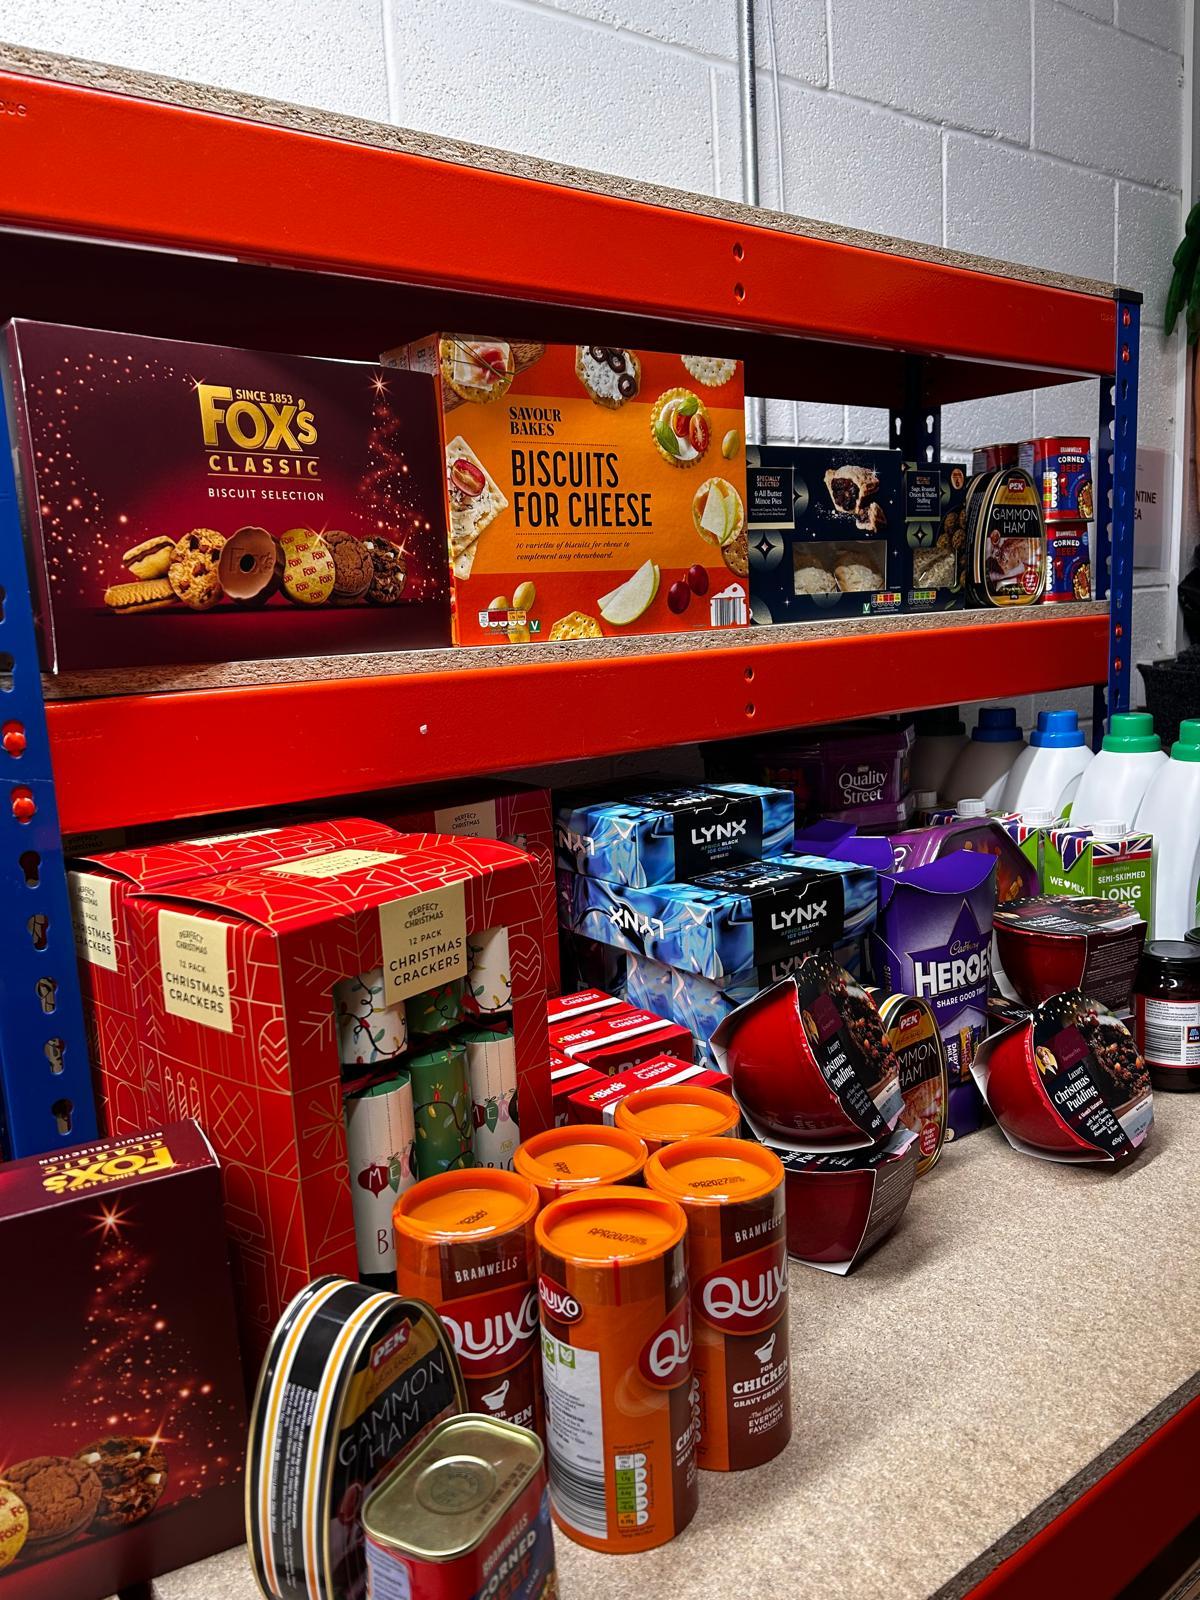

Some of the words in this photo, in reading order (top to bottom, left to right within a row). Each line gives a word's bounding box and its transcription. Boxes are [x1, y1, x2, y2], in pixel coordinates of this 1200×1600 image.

[235, 388, 267, 402] SINCE
[269, 393, 294, 404] 1853
[509, 406, 561, 422] SAVOUR
[510, 421, 555, 436] BAKES
[208, 455, 319, 476] CLASSIC
[1058, 455, 1085, 464] CORNED
[1060, 464, 1082, 472] BEEF
[511, 449, 619, 488] BISCUITS
[208, 487, 257, 500] BISCUIT
[261, 490, 324, 501] SELECTION
[1009, 482, 1024, 492] PEK
[514, 492, 558, 527] FOR
[569, 493, 652, 527] CHEESE
[992, 508, 1038, 521] GAMMON
[1003, 522, 1026, 534] HAM
[516, 541, 523, 549] 10
[525, 541, 553, 549] varieties
[556, 541, 564, 550] of
[565, 540, 590, 548] biscuits
[591, 541, 601, 549] for
[1053, 540, 1080, 548] CORNED
[516, 552, 557, 561] complement
[559, 553, 572, 561] any
[838, 770, 888, 789] Quality
[843, 788, 883, 805] Street
[452, 819, 480, 830] CHRISTMAS
[454, 812, 477, 822] PERFECT
[691, 819, 747, 845] LYNX
[721, 838, 739, 846] BLACK
[1050, 876, 1064, 886] WE
[1072, 882, 1085, 895] MILK
[1098, 871, 1146, 884] SEMI-SKIMMED
[1101, 885, 1141, 899] LONG
[408, 902, 439, 918] PERFECT
[770, 900, 828, 931] LYNX
[404, 910, 444, 929] CHRISTMAS
[609, 905, 665, 940] LYNX
[72, 920, 112, 942] CHRISTMAS
[179, 928, 204, 943] PERFECT
[409, 937, 418, 946] 12
[420, 929, 442, 942] PACK
[781, 927, 801, 937] AFRICA
[801, 921, 820, 930] BLACK
[787, 932, 797, 940] ICE
[797, 929, 813, 938] CHILL
[76, 934, 111, 955] CRACKERS
[176, 940, 208, 955] CHRISTMAS
[950, 940, 979, 956] Cadbury
[389, 937, 462, 972] CHRISTMAS
[179, 960, 186, 968] 12
[188, 962, 206, 973] PACK
[394, 953, 460, 987] CRACKERS
[165, 971, 225, 998] CHRISTMAS
[169, 988, 224, 1014] CRACKERS
[561, 993, 600, 1006] Custard
[936, 996, 959, 1008] SHARE
[959, 989, 976, 1001] GOOD
[565, 1028, 596, 1042] Bird's
[609, 1015, 650, 1028] Custard
[900, 1013, 918, 1030] PEK
[595, 1081, 626, 1098] Bird's
[637, 1062, 677, 1080] Custard
[1067, 1066, 1084, 1080] Luxury
[1054, 1074, 1091, 1105] Christmas
[1066, 1085, 1099, 1112] Pudding
[115, 1132, 163, 1148] BISCUIT
[38, 1141, 110, 1165] SELECTION
[44, 1139, 163, 1174] CLASSIC
[102, 1171, 136, 1183] SINCE
[587, 1227, 633, 1243] APR2027
[454, 1256, 518, 1284] BRAMWELLS
[538, 1277, 579, 1318] QUIXO
[373, 1327, 406, 1367] PEK
[732, 1356, 788, 1394] CHICKEN
[760, 1362, 774, 1374] FOR
[338, 1352, 445, 1467] GAMMON
[733, 1396, 761, 1408] GRAVY
[749, 1404, 784, 1427] EVERYDAY
[749, 1411, 784, 1435] FAVOURITE
[369, 1400, 420, 1469] HAM
